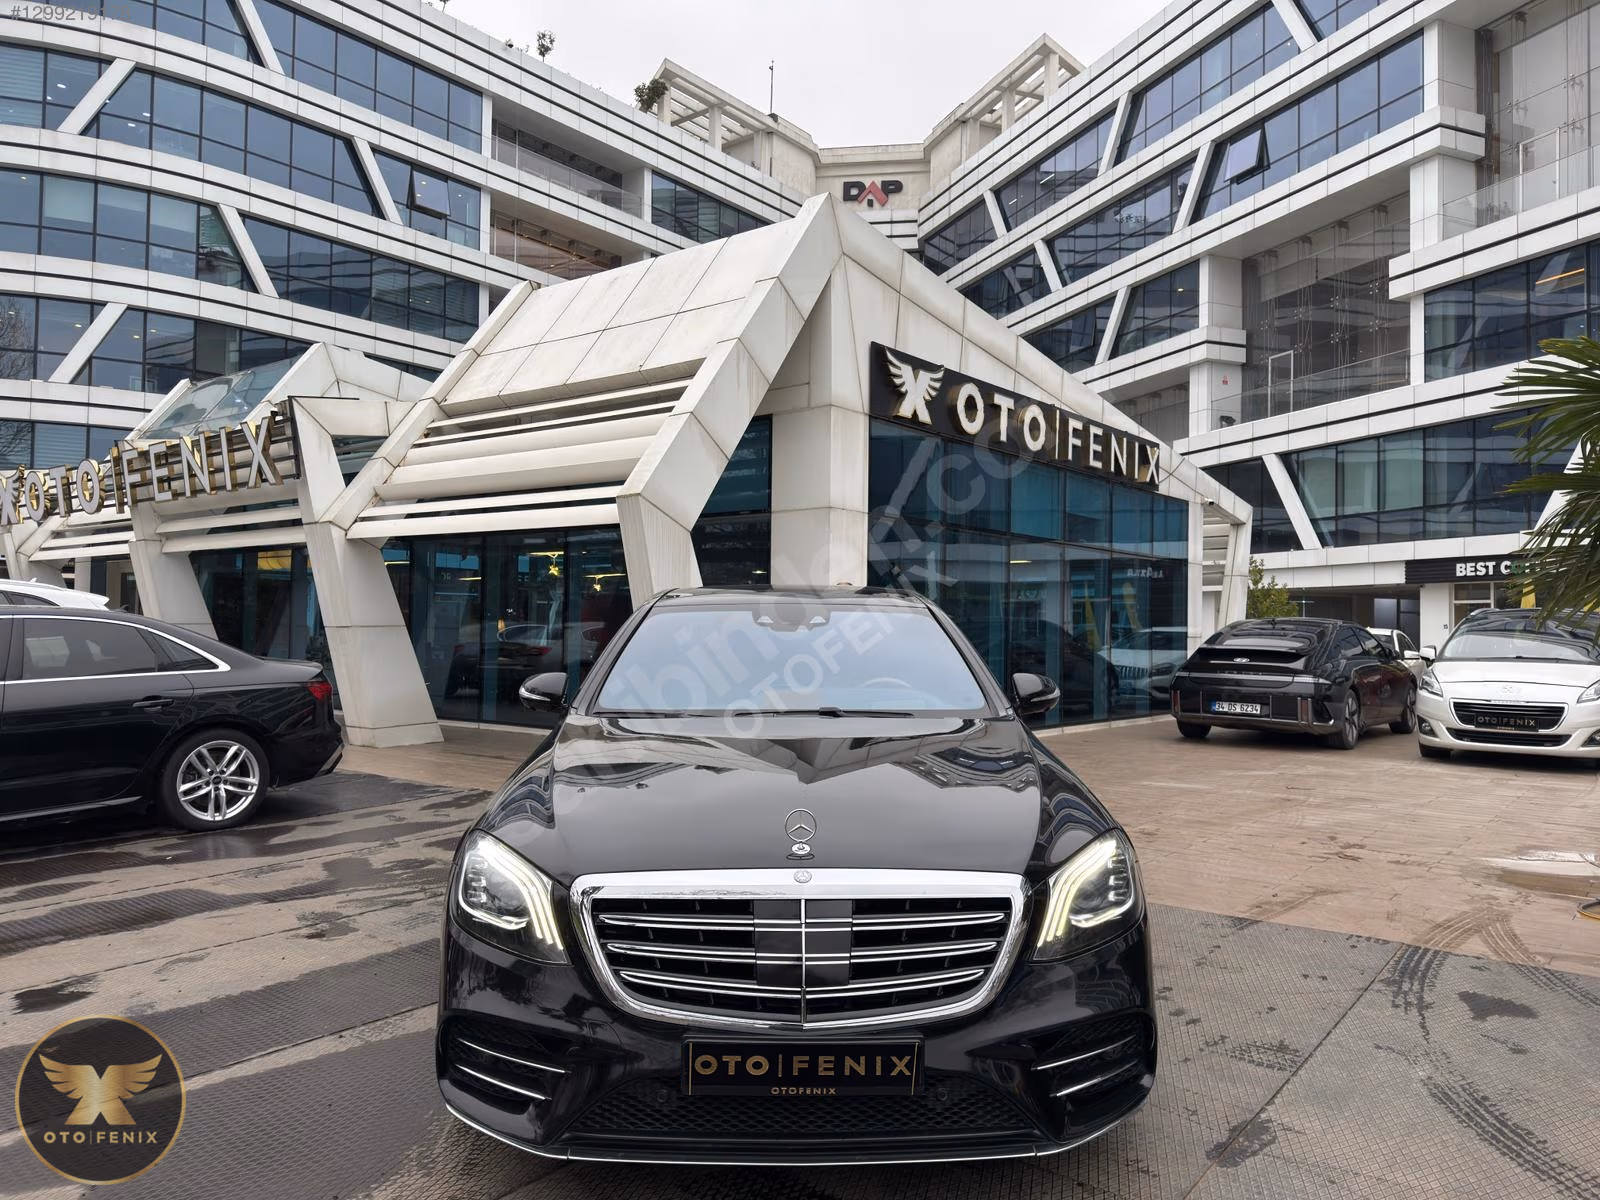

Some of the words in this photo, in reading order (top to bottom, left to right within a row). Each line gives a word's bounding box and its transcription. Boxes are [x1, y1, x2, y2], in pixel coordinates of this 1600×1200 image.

[843, 180, 903, 207] DAP
[1455, 561, 1496, 577] BEST
[1216, 702, 1225, 710] 34
[1240, 703, 1259, 713] 6234
[770, 1086, 837, 1096] OTOFENIX
